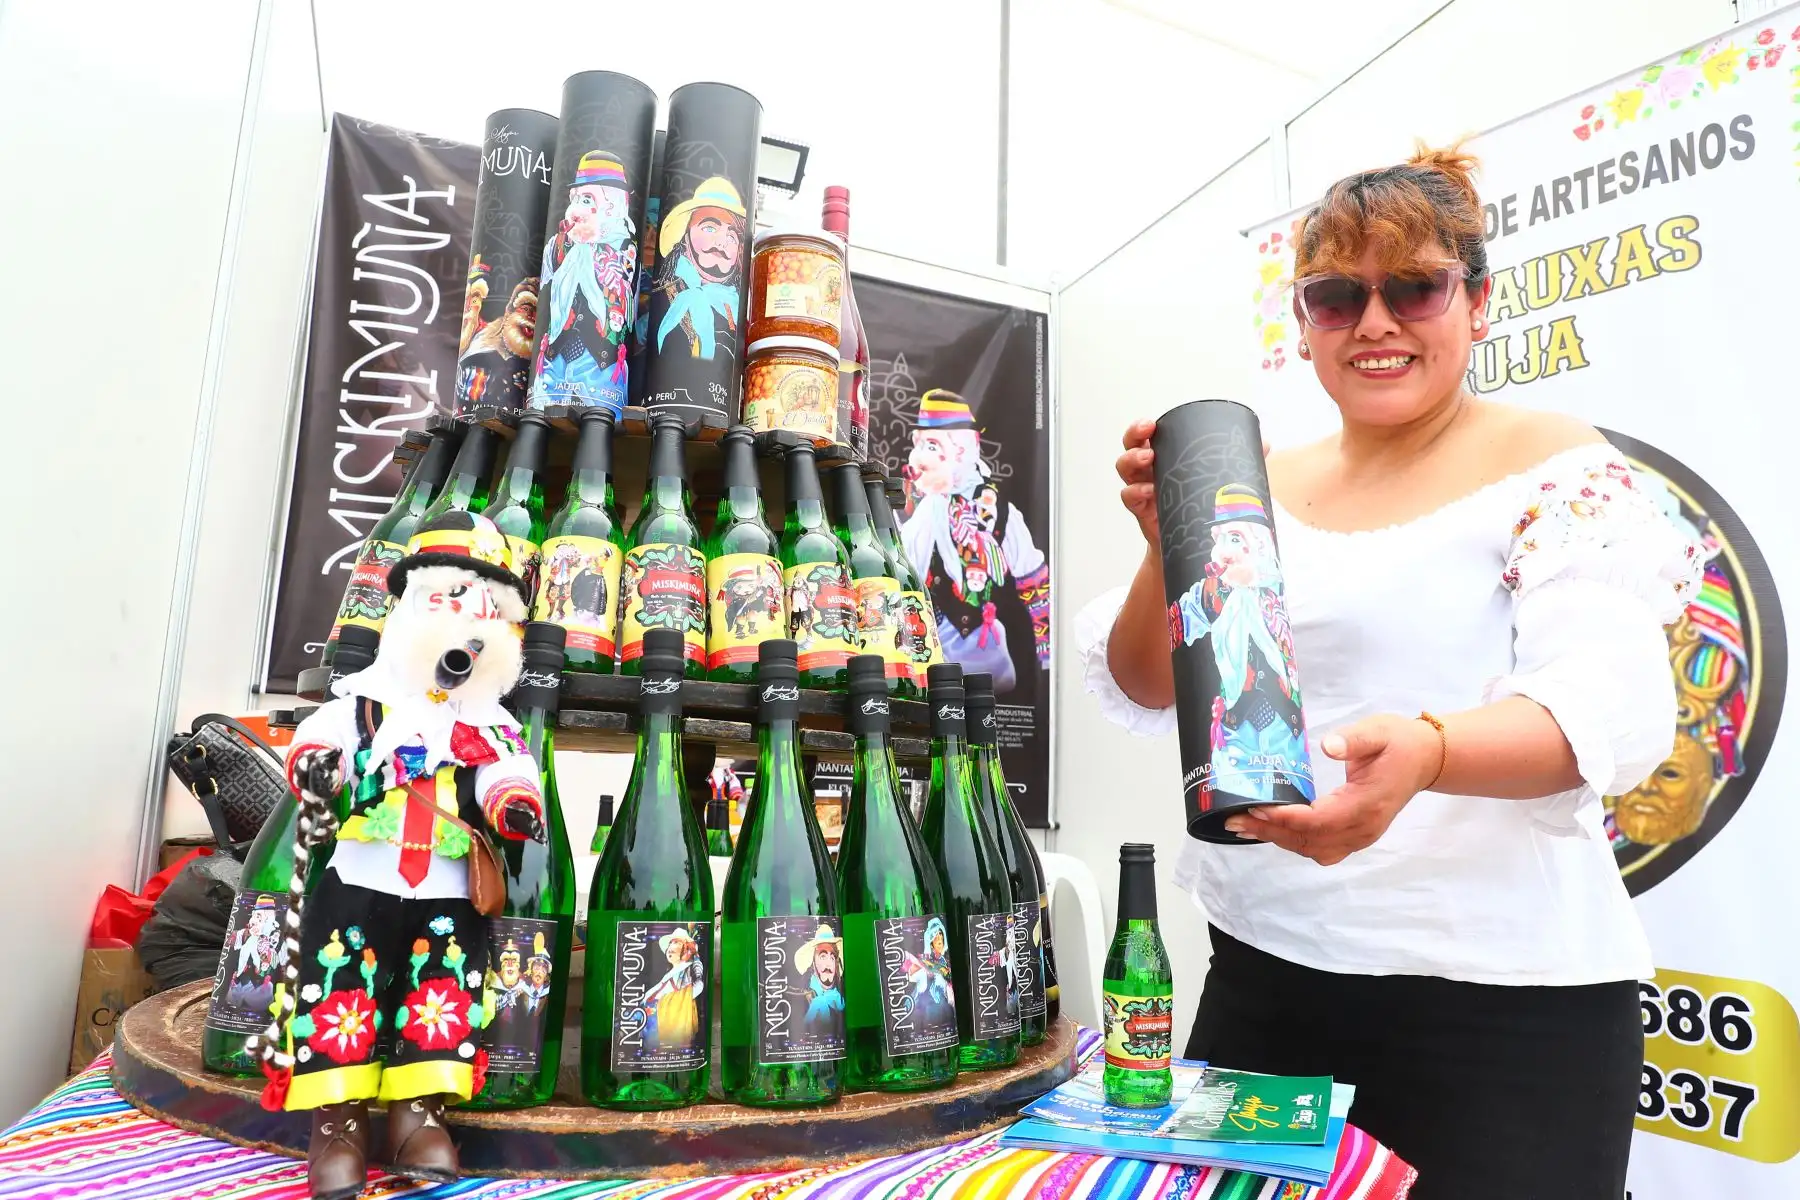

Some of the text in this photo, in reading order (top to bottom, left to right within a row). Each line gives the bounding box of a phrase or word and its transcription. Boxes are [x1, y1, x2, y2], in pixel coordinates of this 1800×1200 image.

[1485, 114, 1756, 243] DE ARTESANOS
[1486, 214, 1703, 325] AUXAS
[322, 175, 456, 576] MISKIMUÑA
[554, 381, 581, 392] JAUJA
[708, 382, 728, 397] 30%
[1468, 315, 1590, 395] UJA
[656, 390, 677, 401] PERÚ
[712, 393, 727, 406] Vol.
[651, 579, 702, 597] MISKIMUÑA
[1248, 755, 1284, 767] JAUJA
[619, 926, 648, 1047] MISKIMUÑA
[765, 921, 791, 1038] MISKIMUÑA
[882, 917, 916, 1031] MISKIMUÑA
[975, 915, 999, 1018] MISKIMUÑA
[1014, 905, 1034, 998] MISKIMUÑA
[1638, 979, 1757, 1055] 686
[1191, 1080, 1238, 1130] Carnavales
[1636, 1061, 1759, 1142] 837
